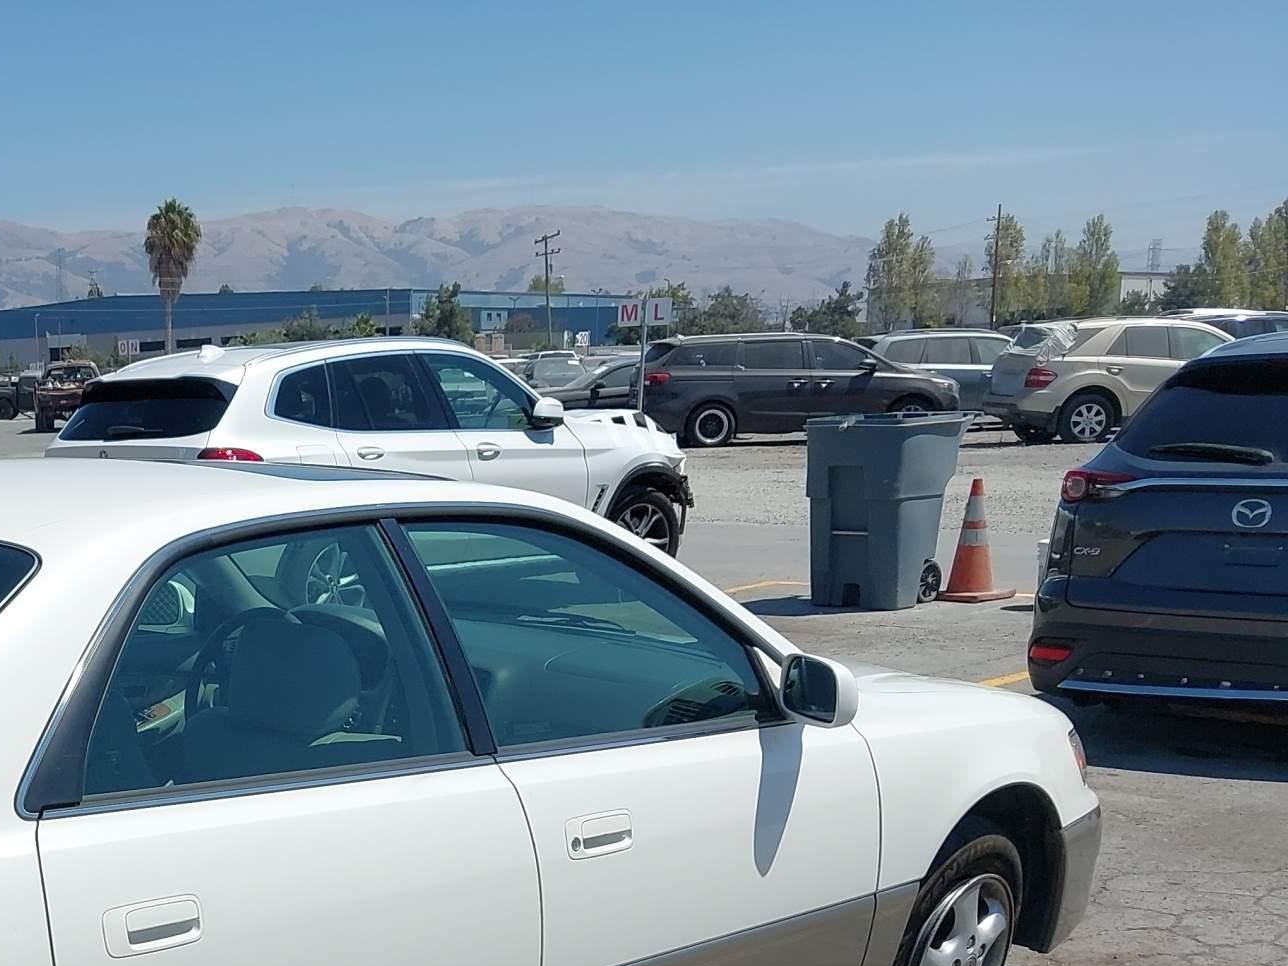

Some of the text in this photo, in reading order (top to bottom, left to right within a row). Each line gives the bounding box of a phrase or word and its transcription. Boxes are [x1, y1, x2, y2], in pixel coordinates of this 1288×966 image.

[621, 303, 638, 321] M
[654, 303, 664, 320] L
[1073, 546, 1101, 556] CX-9
